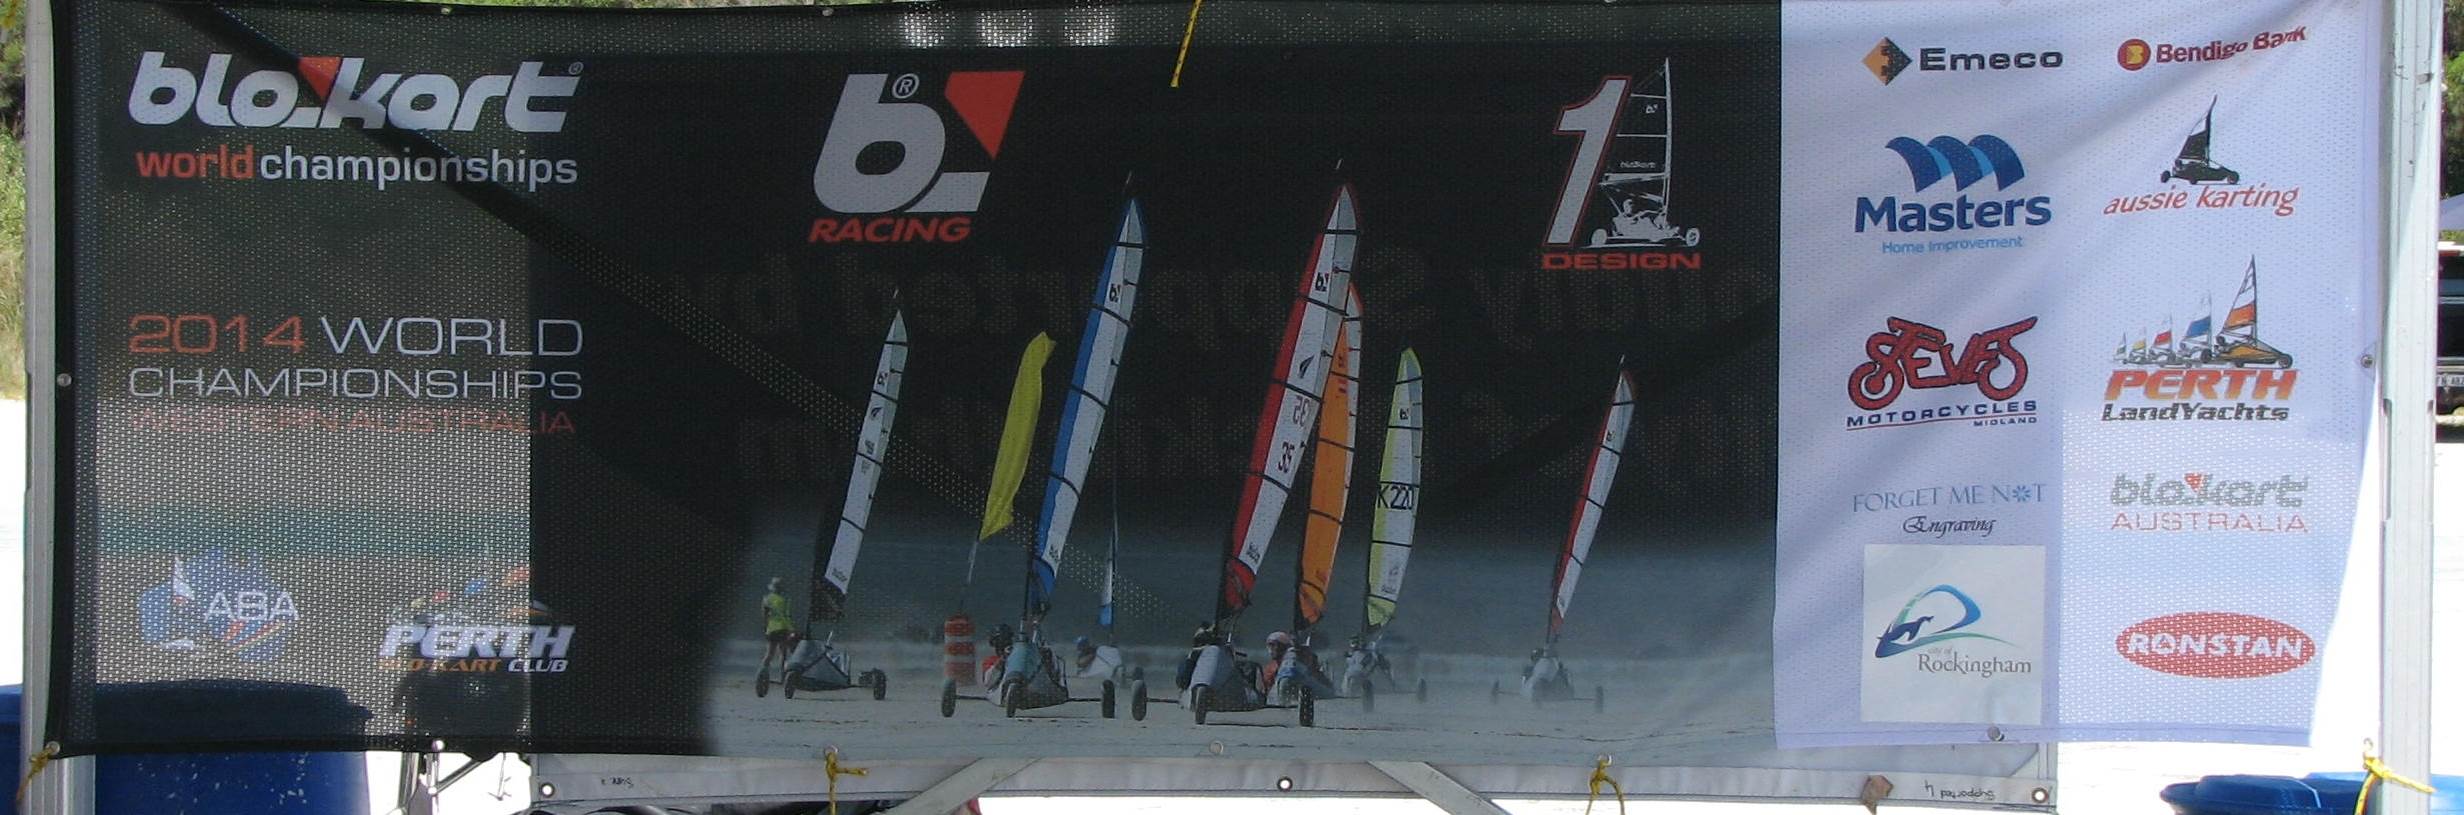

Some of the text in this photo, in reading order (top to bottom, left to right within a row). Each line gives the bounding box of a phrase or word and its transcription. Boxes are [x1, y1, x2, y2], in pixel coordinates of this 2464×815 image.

[1920, 48, 2063, 70] Emeco
[2156, 40, 2249, 63] Bendigo
[135, 144, 579, 193] world championships
[1855, 194, 2051, 232] Masters
[2103, 183, 2300, 217] aussie karting
[809, 217, 972, 243] RACING
[1883, 236, 2023, 255] Home Improvement
[1542, 253, 1701, 270] DESIGN
[128, 313, 583, 357] 2014 WORLD
[128, 367, 582, 400] CHAMPIONSHIPS
[2104, 369, 2298, 401] PERTH
[1847, 400, 2037, 427] MOTORCYCLES
[1974, 417, 2037, 427] MIDLAND
[2101, 402, 2290, 421] LandYachts
[1853, 487, 1943, 513] FORGET
[1949, 485, 1985, 505] ME
[1903, 515, 1997, 538] Engraving
[2111, 512, 2308, 533] AUSTRALIA
[204, 591, 300, 623] ABA
[378, 625, 576, 658] PERTH
[2127, 633, 2304, 659] RONSTAN
[508, 659, 569, 673] CLUB
[1918, 651, 2032, 678] Rockingham
